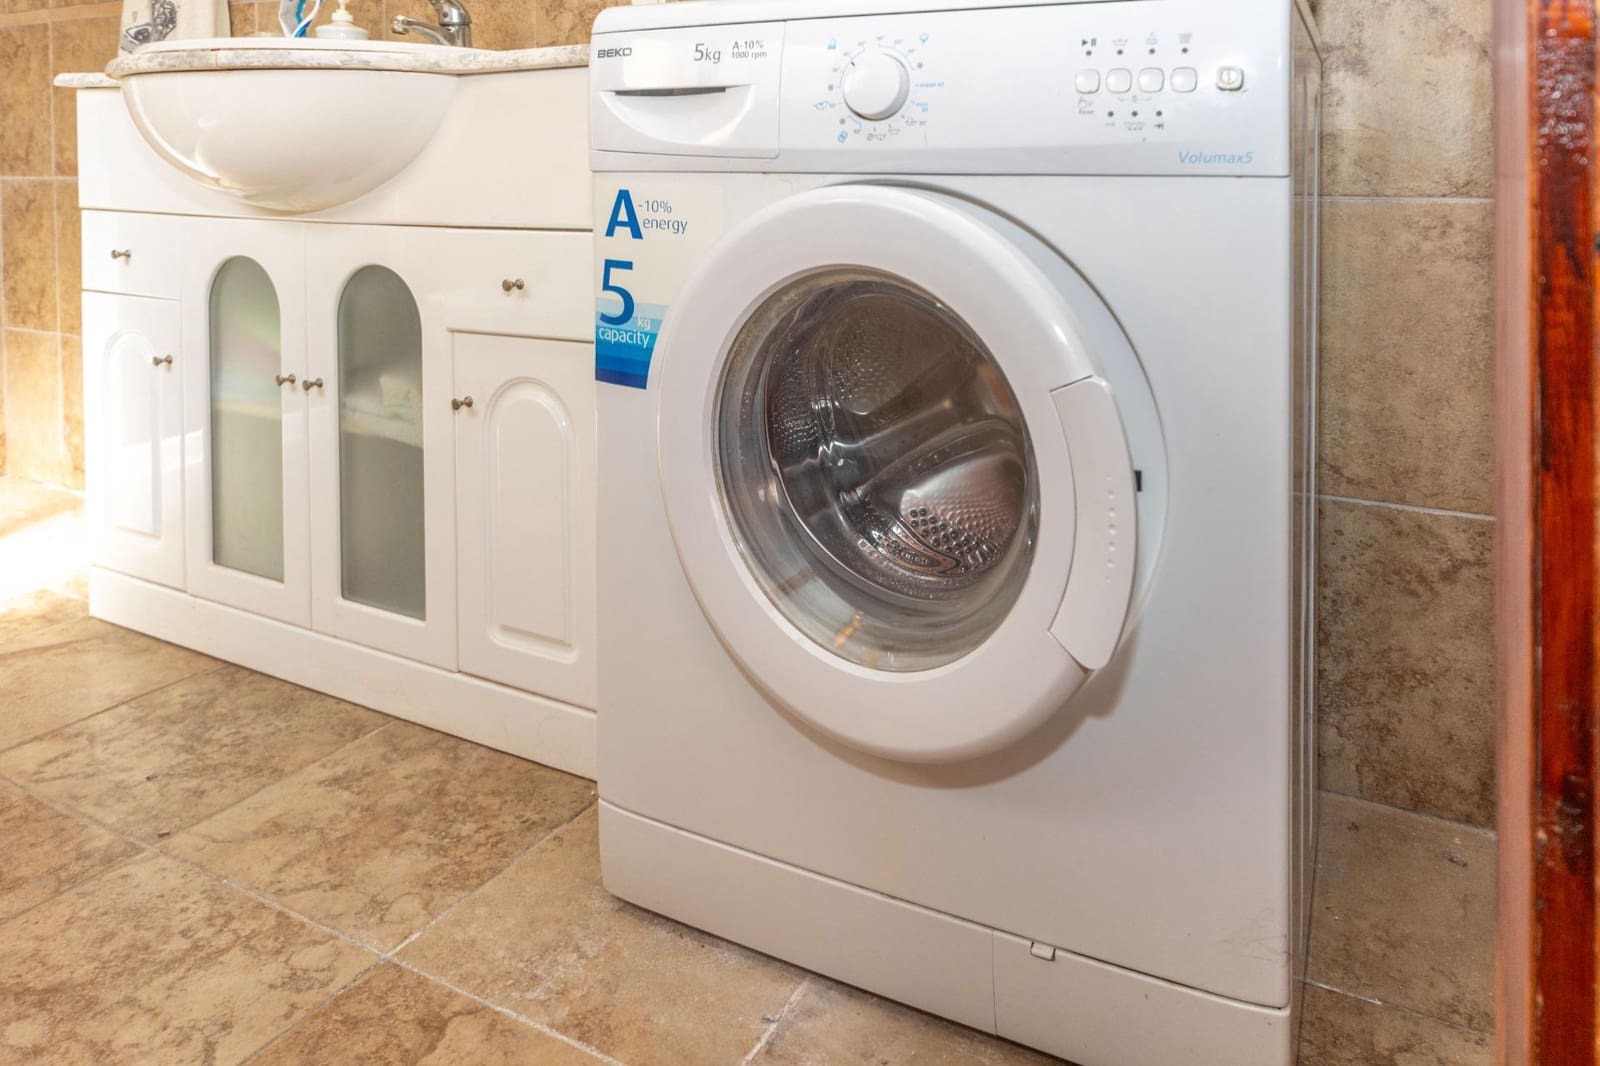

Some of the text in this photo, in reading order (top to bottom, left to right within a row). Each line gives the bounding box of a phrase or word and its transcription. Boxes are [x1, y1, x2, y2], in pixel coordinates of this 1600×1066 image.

[597, 48, 632, 58] BEKO
[694, 43, 721, 64] 5kg
[732, 51, 767, 60] 1000 rpm
[1178, 151, 1254, 164] Volumax5
[605, 189, 643, 240] A
[642, 217, 688, 235] energy
[600, 258, 651, 330] 5 kg
[598, 326, 650, 349] capacity
